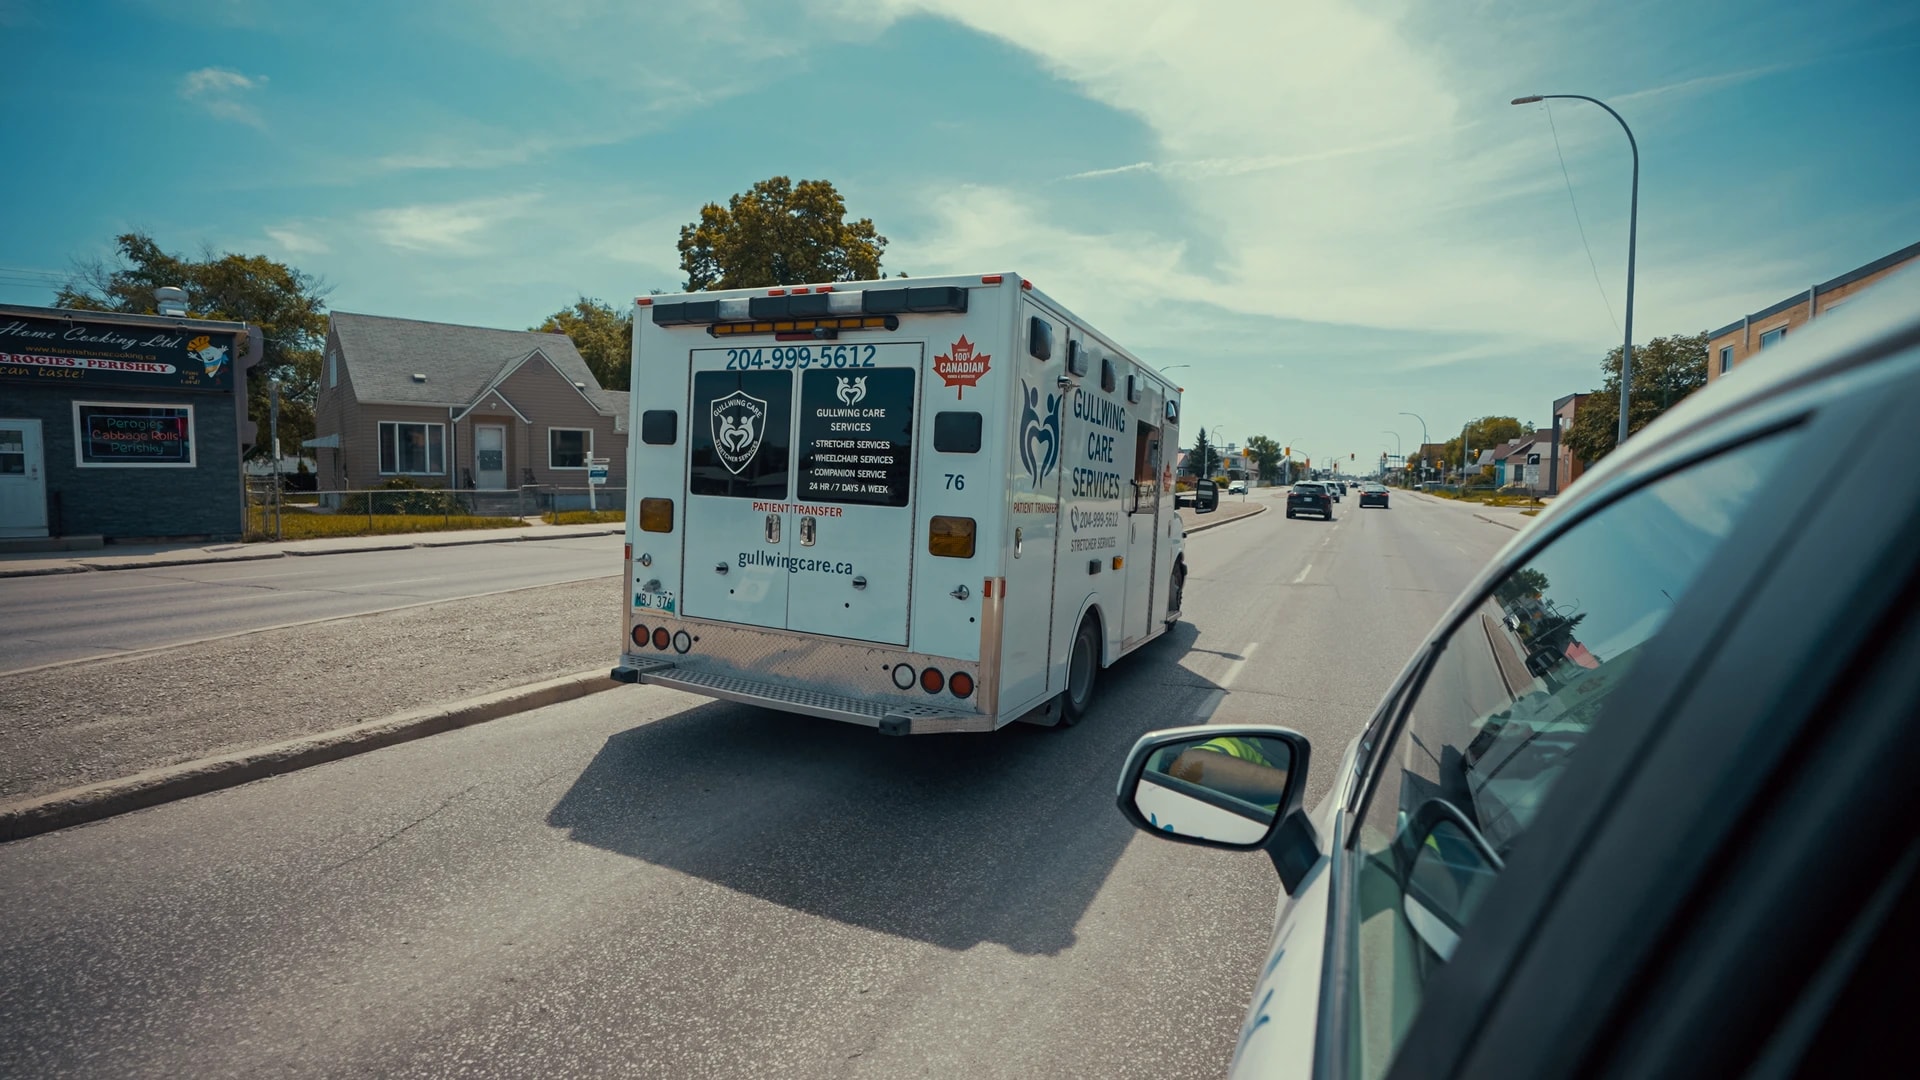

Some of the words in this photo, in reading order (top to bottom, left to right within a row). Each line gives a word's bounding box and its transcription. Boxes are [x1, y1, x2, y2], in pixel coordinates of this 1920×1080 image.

[0, 321, 56, 340] Home
[63, 327, 137, 350] Cooking
[139, 335, 182, 349] Ltd.
[0, 353, 76, 366] EROGIES
[87, 359, 169, 373] PERISHKY
[726, 345, 876, 371] 204-999-5612
[38, 367, 86, 379] taste!
[940, 362, 984, 373] CANADIAN
[713, 399, 746, 417] GULLWING
[746, 402, 762, 418] CARE
[816, 408, 860, 418] GULLWING
[862, 409, 886, 418] CARE
[1073, 388, 1126, 433] GULLWING
[106, 418, 164, 430] Perogies
[830, 422, 871, 432] SERVICES
[92, 430, 148, 442] Cabbage
[151, 430, 179, 441] Rolls
[111, 442, 164, 454] Perishky
[715, 438, 738, 462] STRETCHER
[738, 440, 759, 462] SERVICES
[815, 440, 855, 448] STRETCHER
[856, 441, 890, 450] SERVICES
[1088, 431, 1114, 463] CARE
[815, 454, 858, 463] WHEELCHAIR
[860, 455, 894, 464] SERVICES
[814, 468, 856, 478] COMPANION
[857, 470, 887, 479] SERVICE
[809, 482, 818, 490] 24
[842, 484, 859, 492] DAYS
[868, 485, 888, 494] WEEK
[944, 473, 965, 491] 76
[1072, 467, 1120, 500] SERVICES
[752, 501, 790, 513] PATIENT
[793, 504, 843, 517] TRANSFER
[1013, 502, 1034, 514] PATIENT
[1035, 502, 1059, 514] TRANSFER
[1079, 511, 1119, 528] 204-999-5612
[1070, 538, 1097, 552] STRETCHER
[1097, 536, 1116, 550] SERVICES
[738, 550, 853, 575] gullwingcare.ca
[635, 592, 652, 607] MBJ
